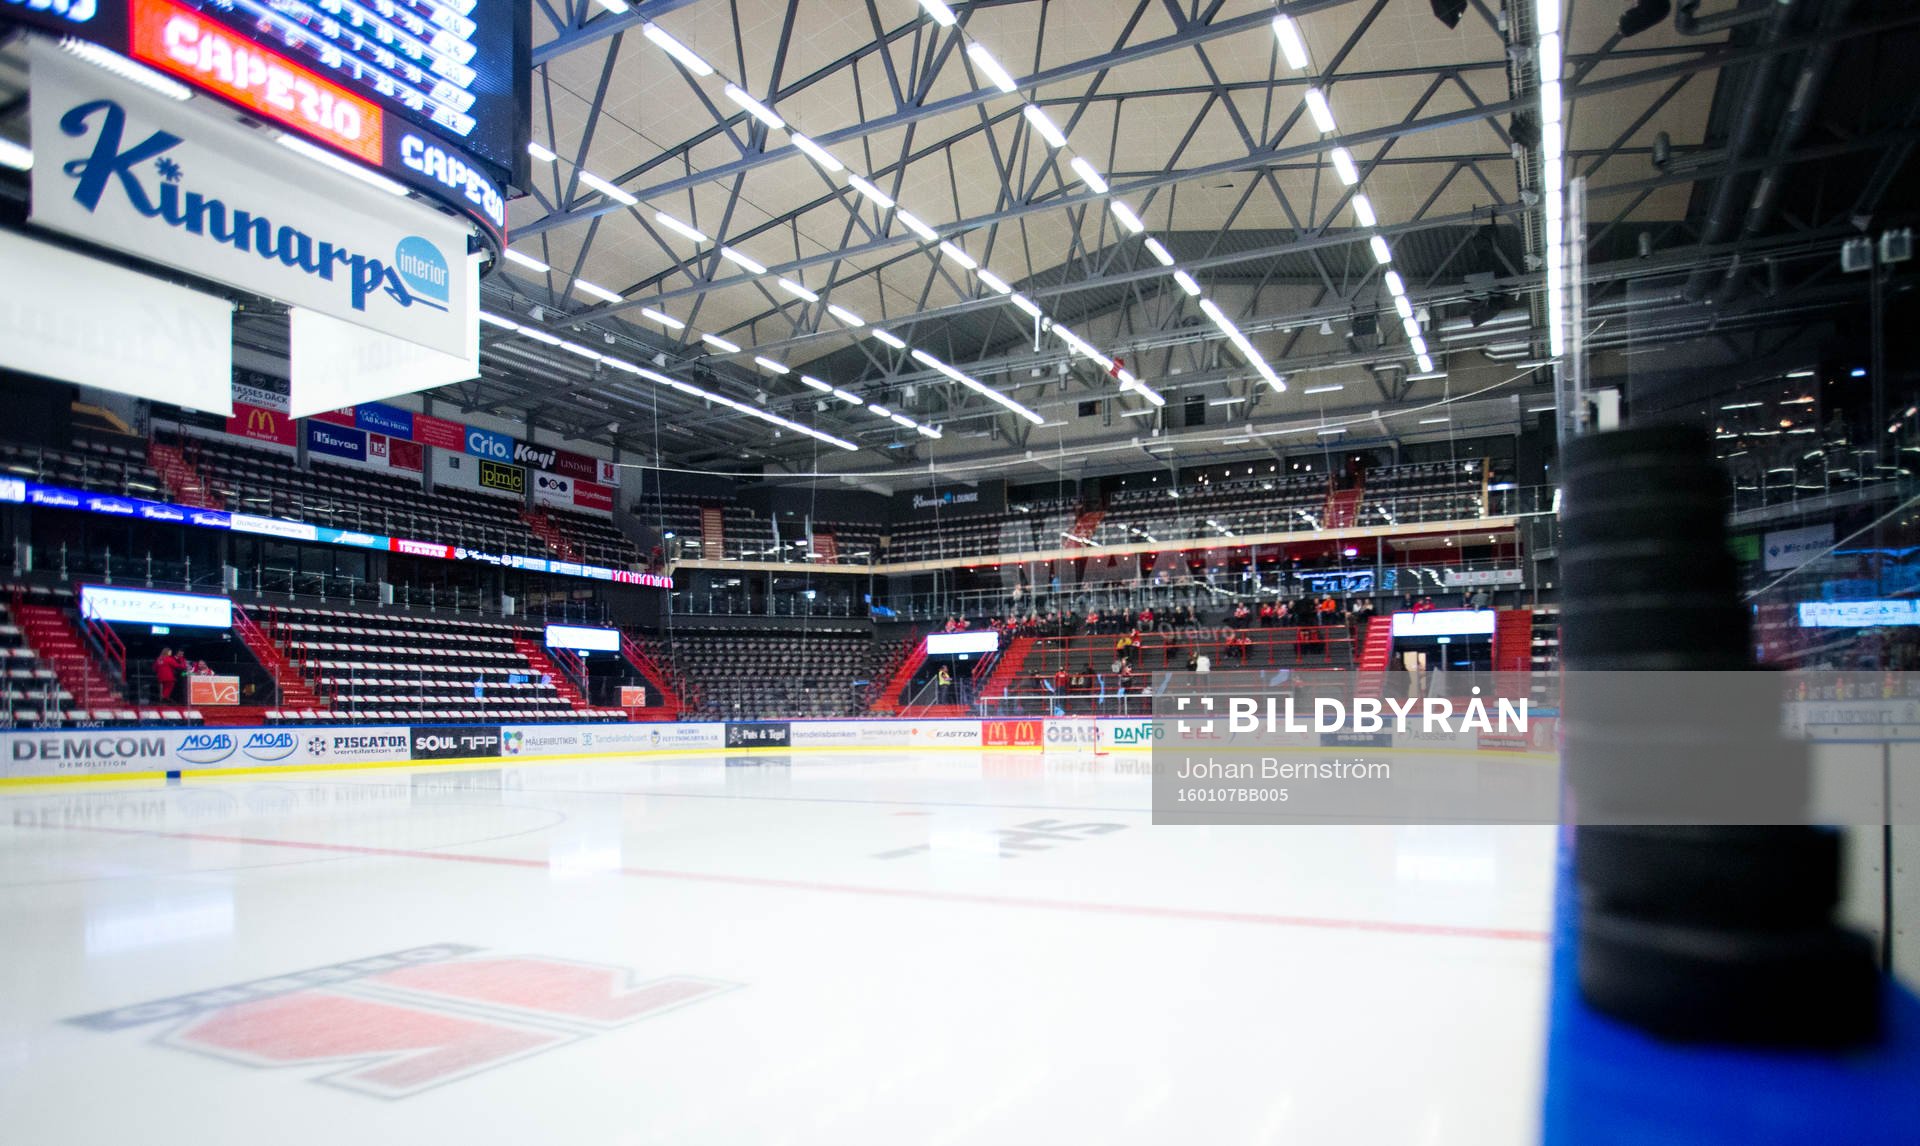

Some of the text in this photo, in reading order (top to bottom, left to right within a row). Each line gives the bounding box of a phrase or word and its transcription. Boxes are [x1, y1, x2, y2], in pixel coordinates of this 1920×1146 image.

[162, 17, 362, 141] CAPERIO
[400, 133, 505, 228] CAPERIO
[60, 99, 449, 313] Kinnarps
[401, 250, 447, 287] interior
[469, 432, 510, 459] Crio.
[560, 459, 595, 474] LINDAHL
[484, 468, 521, 487] pmc
[176, 734, 232, 752] MOAB
[242, 732, 293, 750] MOAB
[334, 736, 407, 749] PISCATOR
[416, 735, 457, 750] SOUL
[1114, 724, 1165, 743] DANFO
[12, 737, 166, 761] DEMCOM
[58, 760, 127, 769] DEMOLITION
